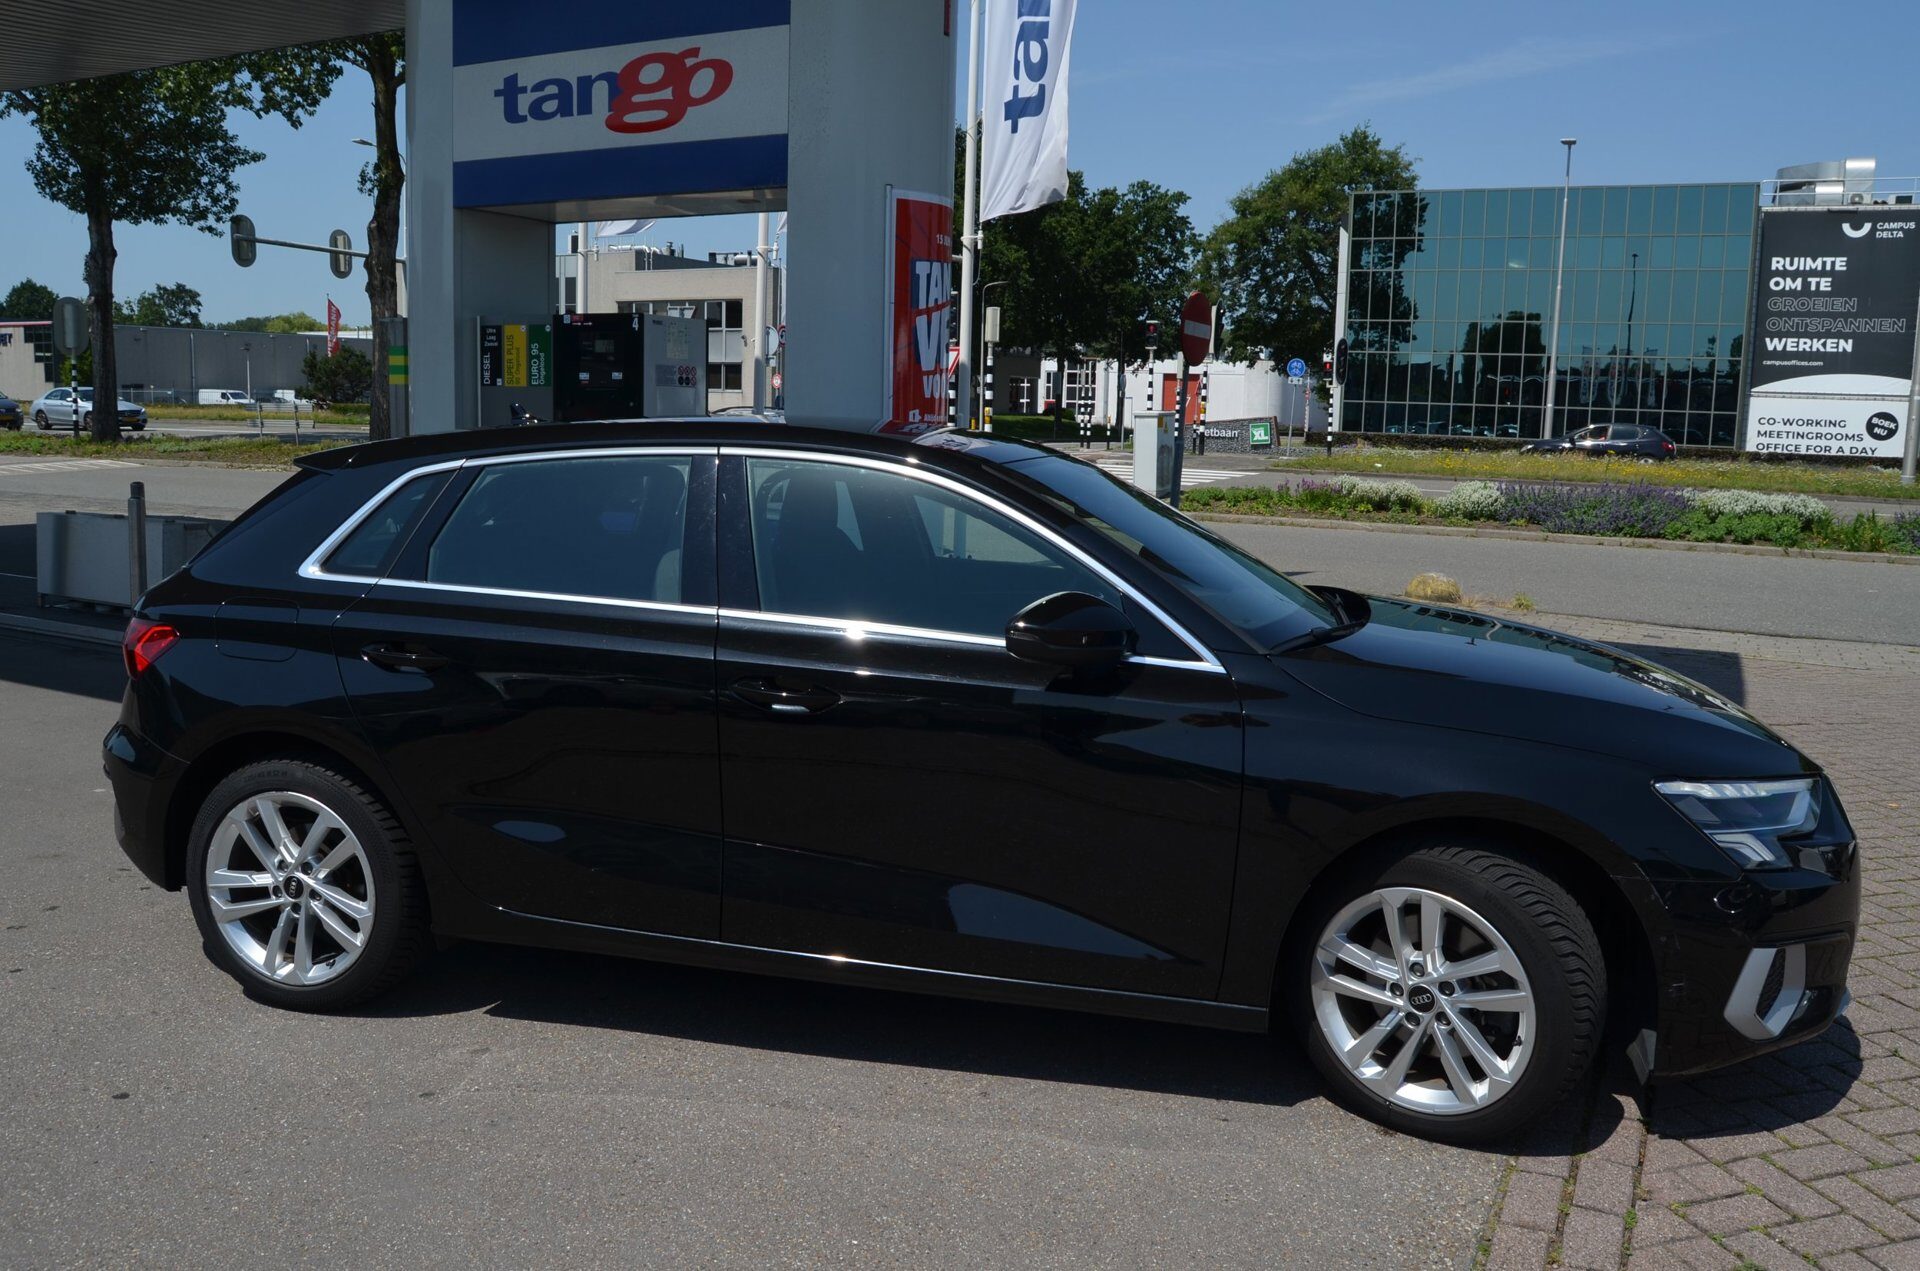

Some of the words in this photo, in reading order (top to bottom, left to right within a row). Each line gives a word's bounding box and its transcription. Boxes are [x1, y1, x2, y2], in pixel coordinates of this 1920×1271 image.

[494, 47, 733, 133] tango
[1770, 257, 1848, 271] RUIMTE
[1769, 277, 1802, 291] OM
[1807, 277, 1832, 291] TE
[1767, 297, 1858, 312] GROEIEN
[1766, 317, 1906, 333] ONTSPANNEN
[506, 334, 514, 355] PLUS
[531, 343, 539, 356] 95
[1765, 337, 1853, 352] WERKEN
[483, 352, 491, 384] DIESEL
[1762, 359, 1824, 367] campusoffices.com
[506, 359, 514, 385] SUPER
[531, 358, 539, 385] EURO
[1757, 417, 1847, 428] CO-WORKING
[1870, 416, 1897, 429] BOEK
[1756, 430, 1864, 442] MEETINGROOMS
[1873, 427, 1888, 436] NU
[1755, 442, 1802, 453] OFFICE
[1805, 444, 1832, 454] FOR
[1836, 446, 1845, 454] A
[1849, 446, 1878, 455] DAY
